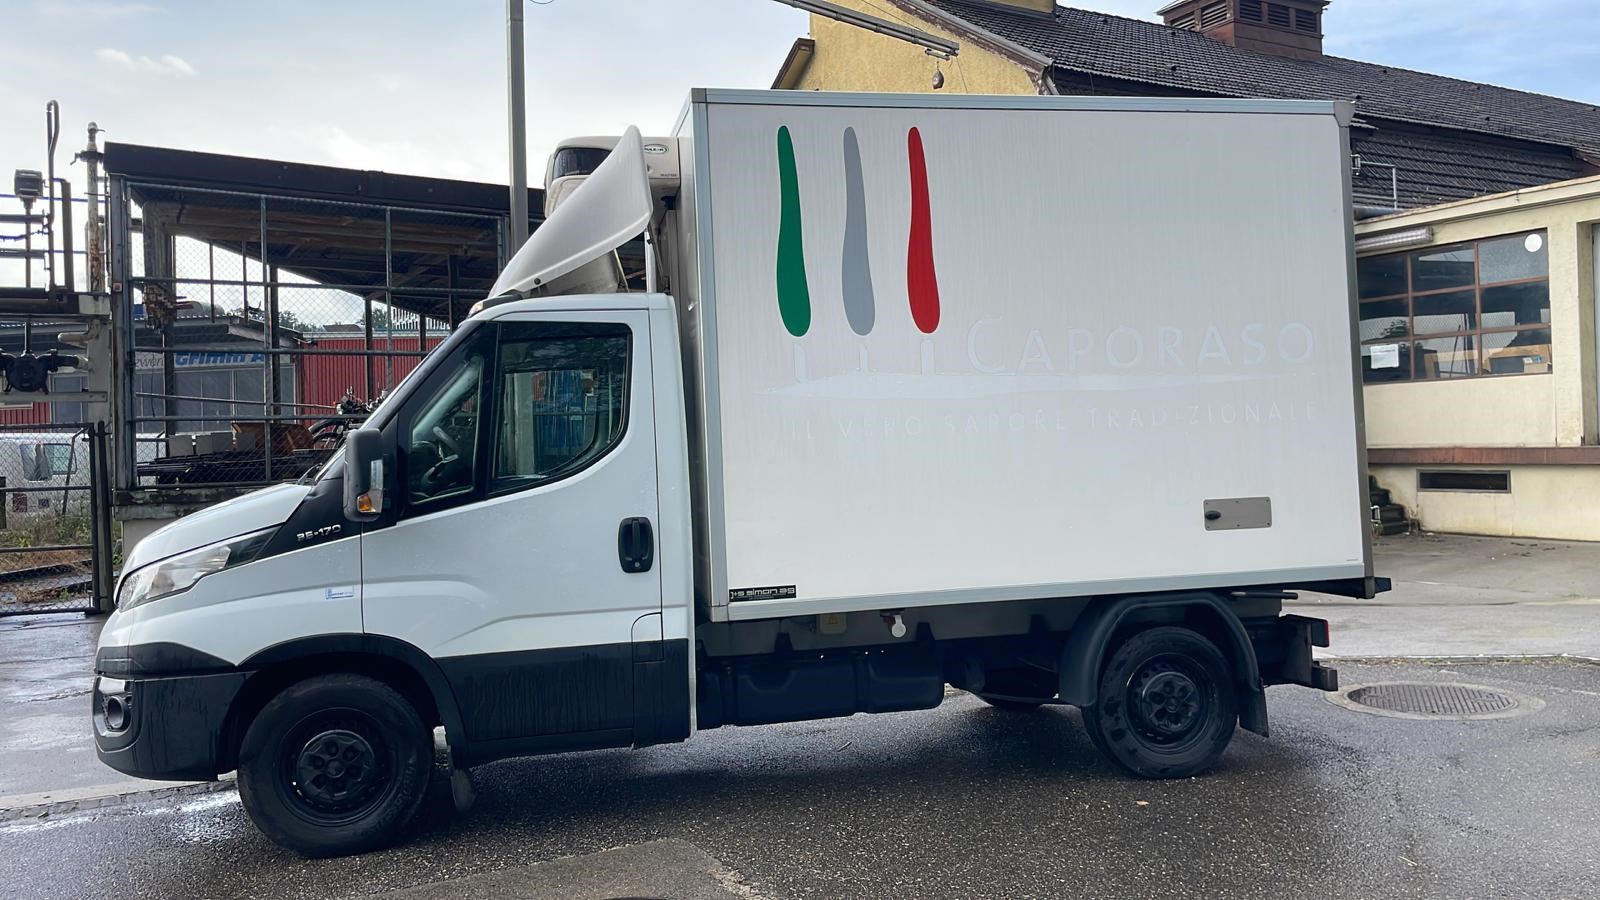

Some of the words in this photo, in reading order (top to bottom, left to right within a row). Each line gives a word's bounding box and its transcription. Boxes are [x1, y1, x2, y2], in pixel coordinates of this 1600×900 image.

[967, 315, 1314, 376] CAPORASO
[839, 416, 922, 439] VERO
[944, 409, 1066, 434] SAPORE
